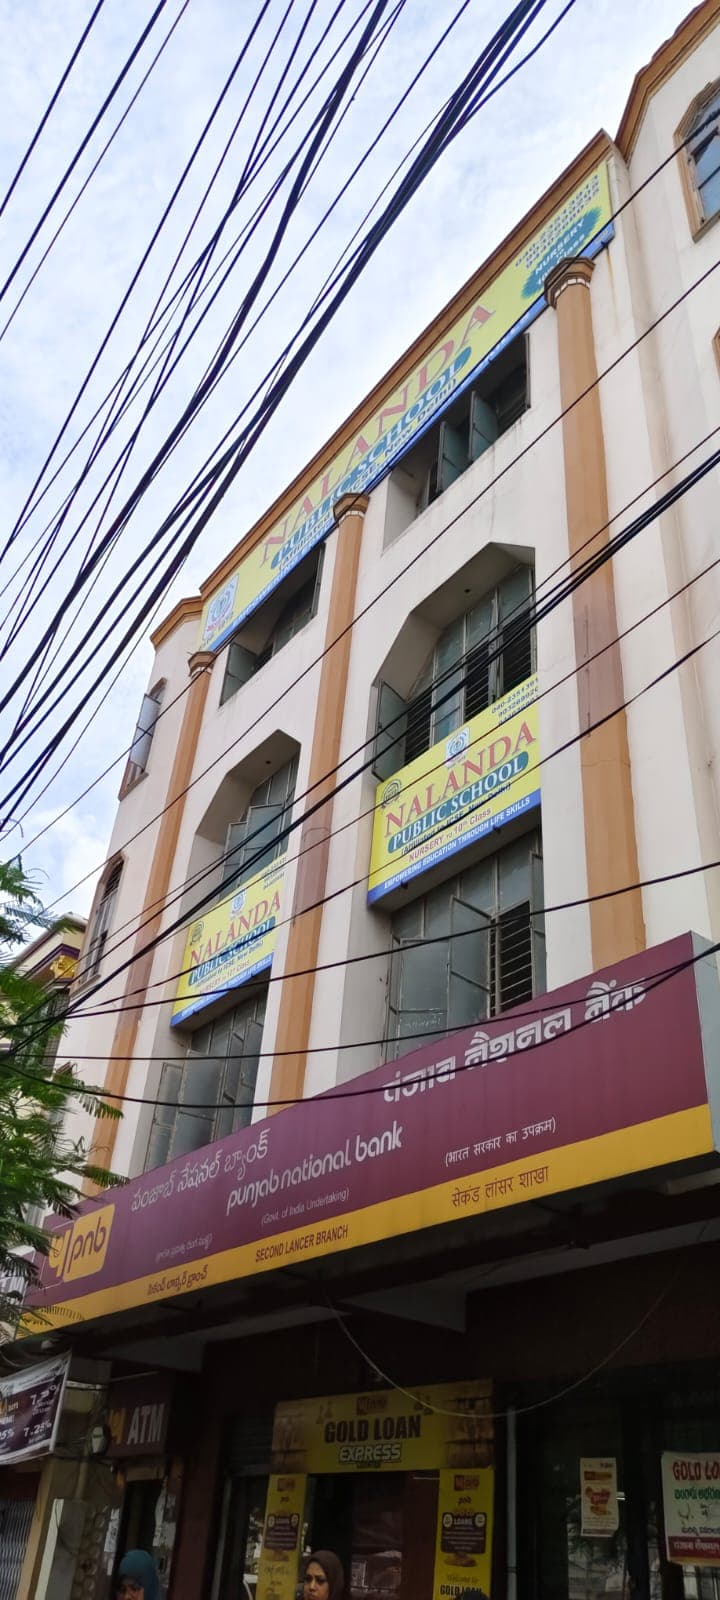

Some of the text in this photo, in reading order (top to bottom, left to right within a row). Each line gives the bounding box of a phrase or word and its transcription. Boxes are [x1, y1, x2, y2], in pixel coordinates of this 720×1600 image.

[535, 218, 585, 275] NURSERY
[260, 305, 495, 568] NALANDA
[277, 473, 351, 562] PUBLIC
[355, 353, 462, 478] SCHOOL
[384, 423, 411, 457] New
[384, 721, 536, 838] NALANDA
[392, 804, 449, 850] PUBLIC
[450, 757, 523, 816] SCHOOL
[409, 834, 443, 862] NURSERY
[469, 805, 491, 825] Class
[422, 840, 455, 866] EDUCATION
[457, 820, 488, 845] THROUGH
[490, 810, 504, 826] LIFE
[506, 795, 529, 816] SKILLS
[190, 891, 280, 968] NALANDA
[191, 953, 224, 984] PUBLIC
[382, 977, 646, 1102] पंजाब नैशनल बैंक
[445, 1116, 556, 1167] (भारत सरकार का उपक्रम)
[131, 1128, 271, 1213] పంజాబ్ నేషనల్ బ్యాంక్
[226, 1120, 403, 1216] punjab national bank
[451, 1165, 549, 1209] सेकंड लांसर शाखा
[281, 1208, 288, 1219] of
[289, 1204, 305, 1217] India
[306, 1188, 349, 1211] Undertaking)
[71, 1217, 107, 1260] pnb
[255, 1224, 348, 1262] SECOND LANCER BRANCH
[126, 1403, 165, 1445] ATM
[325, 1414, 421, 1443] GOLD LOAN
[340, 1443, 401, 1461] EXPRESS
[673, 1461, 701, 1480] GOLD
[440, 1585, 460, 1596] GOLD
